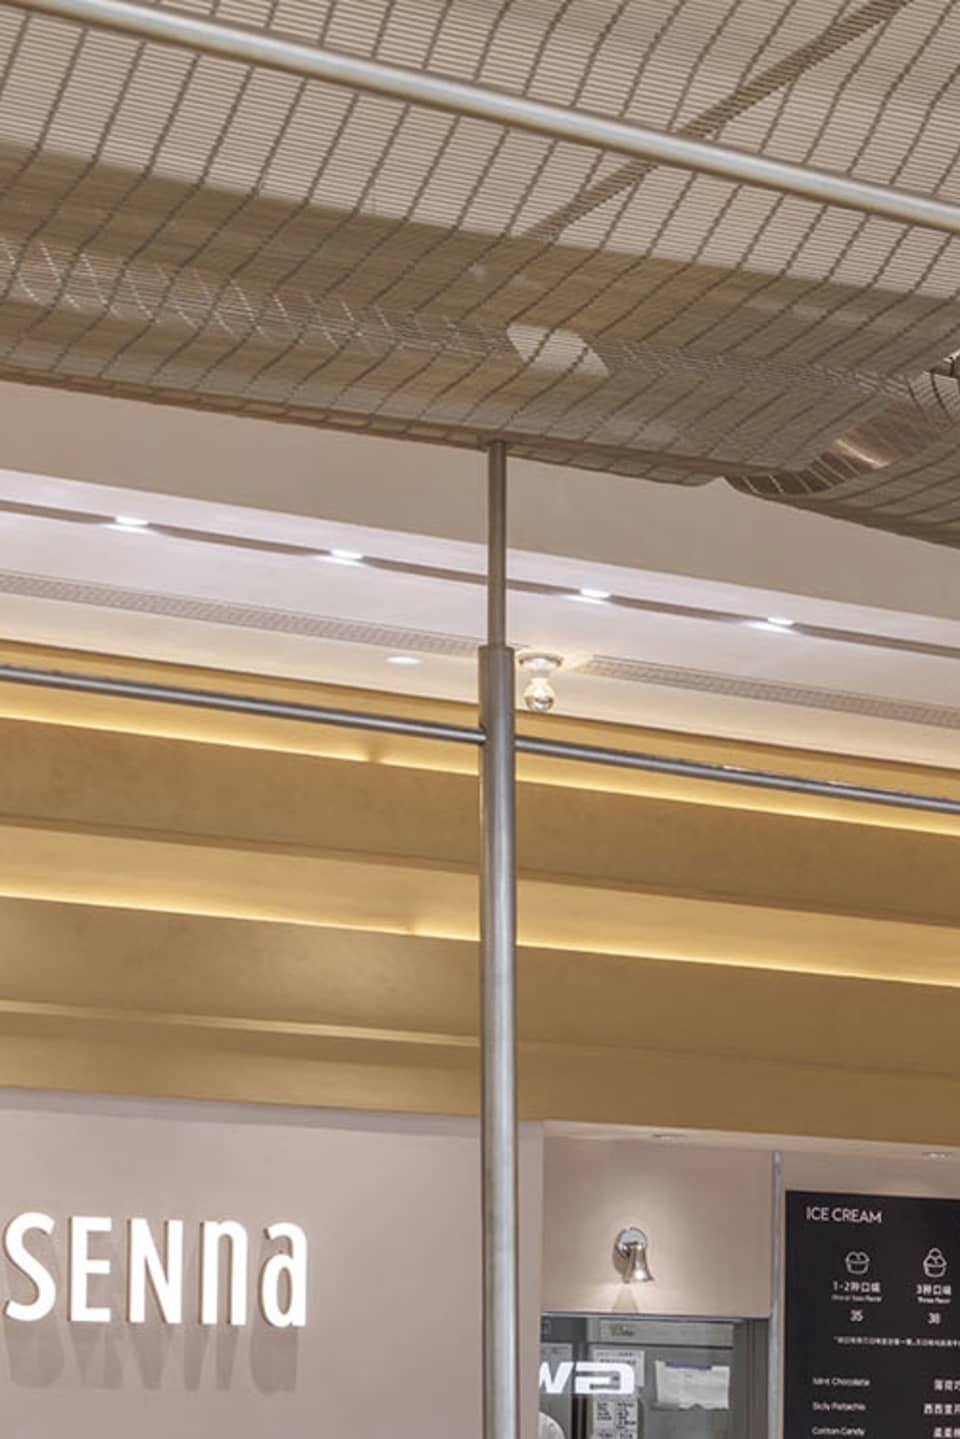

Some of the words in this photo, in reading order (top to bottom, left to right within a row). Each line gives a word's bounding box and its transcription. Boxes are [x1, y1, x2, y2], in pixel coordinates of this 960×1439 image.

[806, 1206, 829, 1222] ICE
[831, 1207, 883, 1224] CREAM
[850, 1309, 864, 1322] 35
